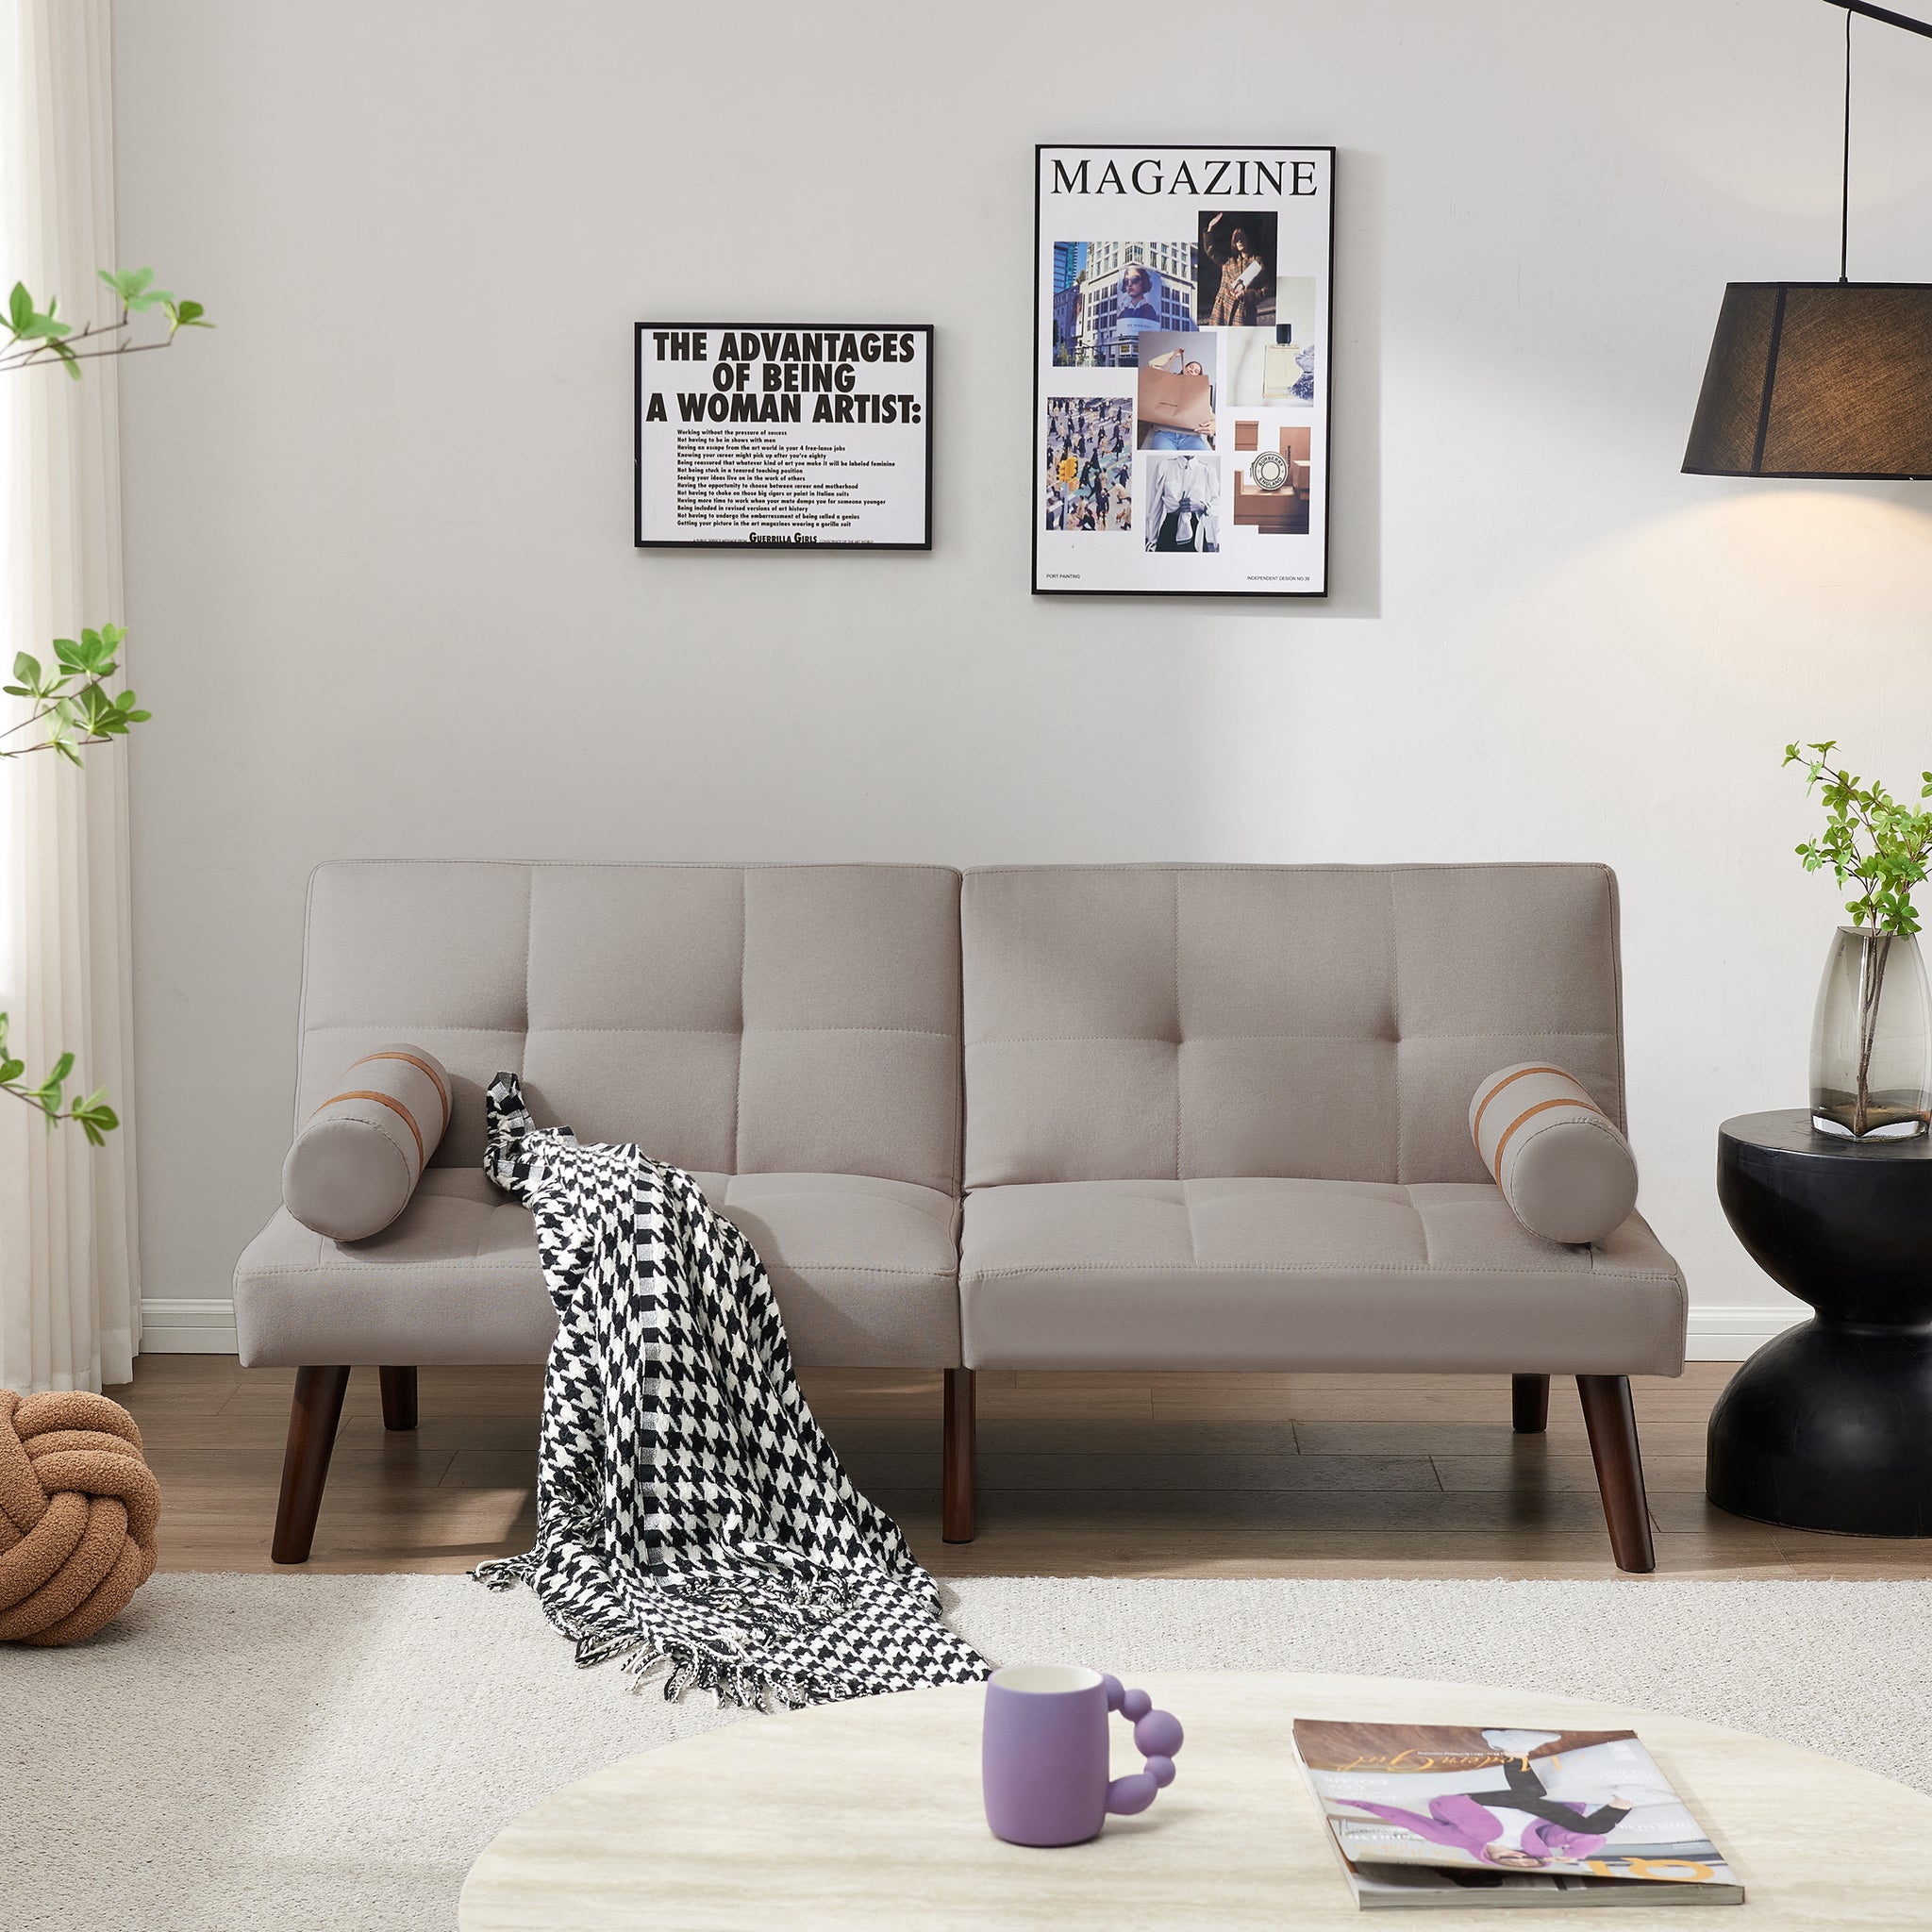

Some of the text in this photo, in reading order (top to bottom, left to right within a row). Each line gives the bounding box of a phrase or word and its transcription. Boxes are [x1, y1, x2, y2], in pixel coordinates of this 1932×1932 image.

[1051, 159, 1318, 196] MAGAZINE
[653, 331, 915, 363] THE ADVANTAGES
[712, 362, 856, 393] OF BEING
[645, 392, 922, 425] A WOMAN ARTIST:
[1258, 455, 1283, 467] BURBERRY
[1259, 477, 1283, 487] ENGLAND
[749, 532, 792, 543] GUERRILLA
[794, 532, 817, 543] GIRLS
